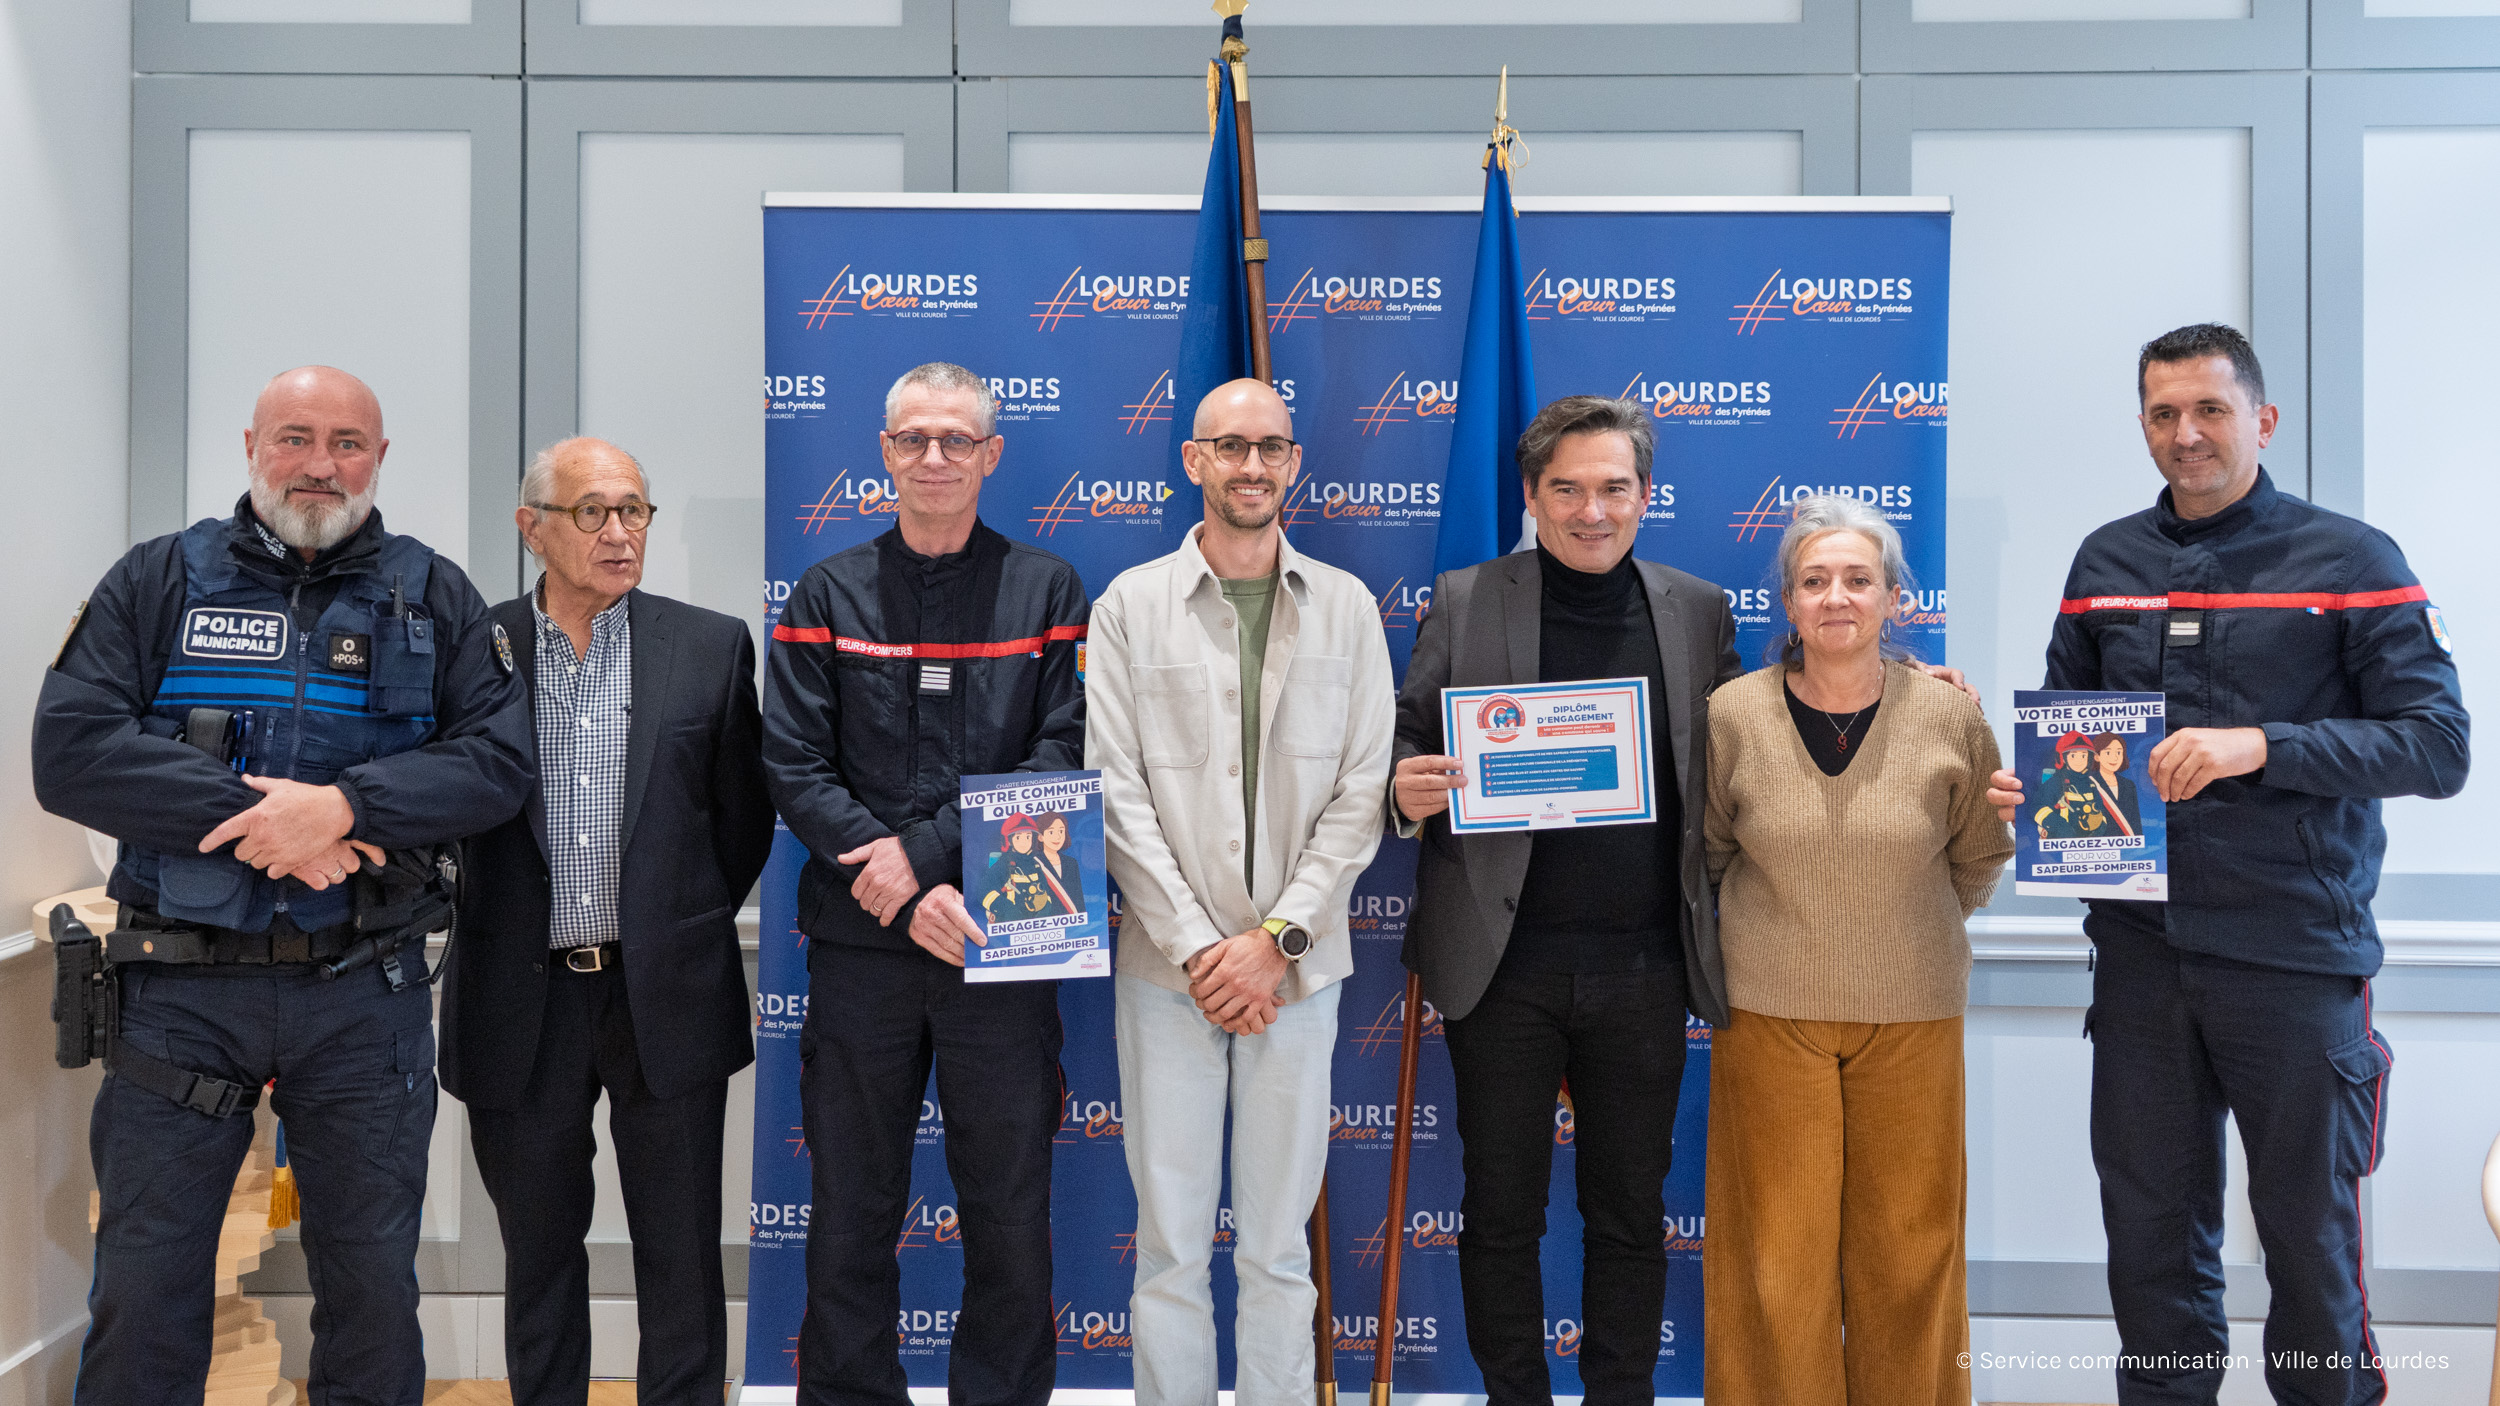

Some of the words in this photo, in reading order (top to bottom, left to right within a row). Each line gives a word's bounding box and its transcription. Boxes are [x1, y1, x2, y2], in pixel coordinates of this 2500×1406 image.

[849, 274, 978, 296] LOURDES
[1080, 276, 1190, 297] LOURDE
[1312, 277, 1441, 298] LOURDES
[1545, 278, 1676, 299] LOURDES
[1780, 278, 1912, 300] LOURDES
[940, 300, 977, 310] Pyrénées
[1154, 302, 1169, 310] des
[1386, 303, 1401, 311] des
[1403, 303, 1441, 313] Pyrénées
[1620, 304, 1635, 312] des
[1637, 304, 1676, 314] Pyrénées
[1856, 304, 1871, 312] des
[1873, 304, 1912, 314] Pyrénées
[765, 376, 826, 397] RDES
[990, 378, 1060, 399] RDES
[1641, 382, 1770, 403] LOURDES
[1880, 382, 1948, 403] LOUR
[788, 401, 825, 411] Pyrénées
[1006, 403, 1020, 411] des
[1022, 403, 1060, 413] Pyrénées
[1715, 407, 1730, 416] des
[1732, 407, 1770, 418] Pyrénées
[1078, 481, 1166, 502] LOUR
[1311, 483, 1440, 504] LOURDES
[1385, 509, 1400, 517] des
[1402, 509, 1440, 519] Pyrénées
[1641, 510, 1675, 520] yrénées
[2091, 598, 2168, 608] SAPEURS-POMPIERS
[194, 615, 278, 637] POLICE
[191, 635, 276, 652] MUNICIPALE
[836, 639, 912, 656] PEURS-POMPIERS
[1553, 703, 1596, 713] DIPLÔME
[2018, 708, 2072, 720] VOTRE
[2078, 705, 2161, 718] COMMUNE
[1537, 713, 1614, 724] D'ENGAGEMENT
[2048, 723, 2075, 734] QUI
[2082, 721, 2135, 732] SAUVE
[965, 790, 1016, 806] VOTRE
[1022, 781, 1100, 799] COMMUNE
[993, 805, 1020, 817] QUI
[1025, 798, 1076, 814] SAUVE
[2043, 838, 2141, 849] ENGAGEZ-VOUS
[2067, 852, 2094, 860] POUR
[2037, 863, 2152, 873] SAPEURS-POMPIERS
[992, 915, 1084, 934] ENGAGEZ-VOUS
[1383, 922, 1397, 930] des
[1014, 934, 1040, 943] POUR
[1043, 931, 1061, 940] VOS
[986, 939, 1095, 959] SAPEURS-POMPIERS
[764, 1019, 777, 1028] des
[779, 1021, 802, 1031] Pyrén
[750, 1202, 812, 1226] RDES
[1413, 1220, 1458, 1248] Cœu
[897, 1310, 961, 1332] RDES
[909, 1337, 924, 1345] des
[927, 1337, 951, 1347] Pyrén
[1083, 1321, 1132, 1349] Cœu
[1399, 1344, 1437, 1354] Pyrénées
